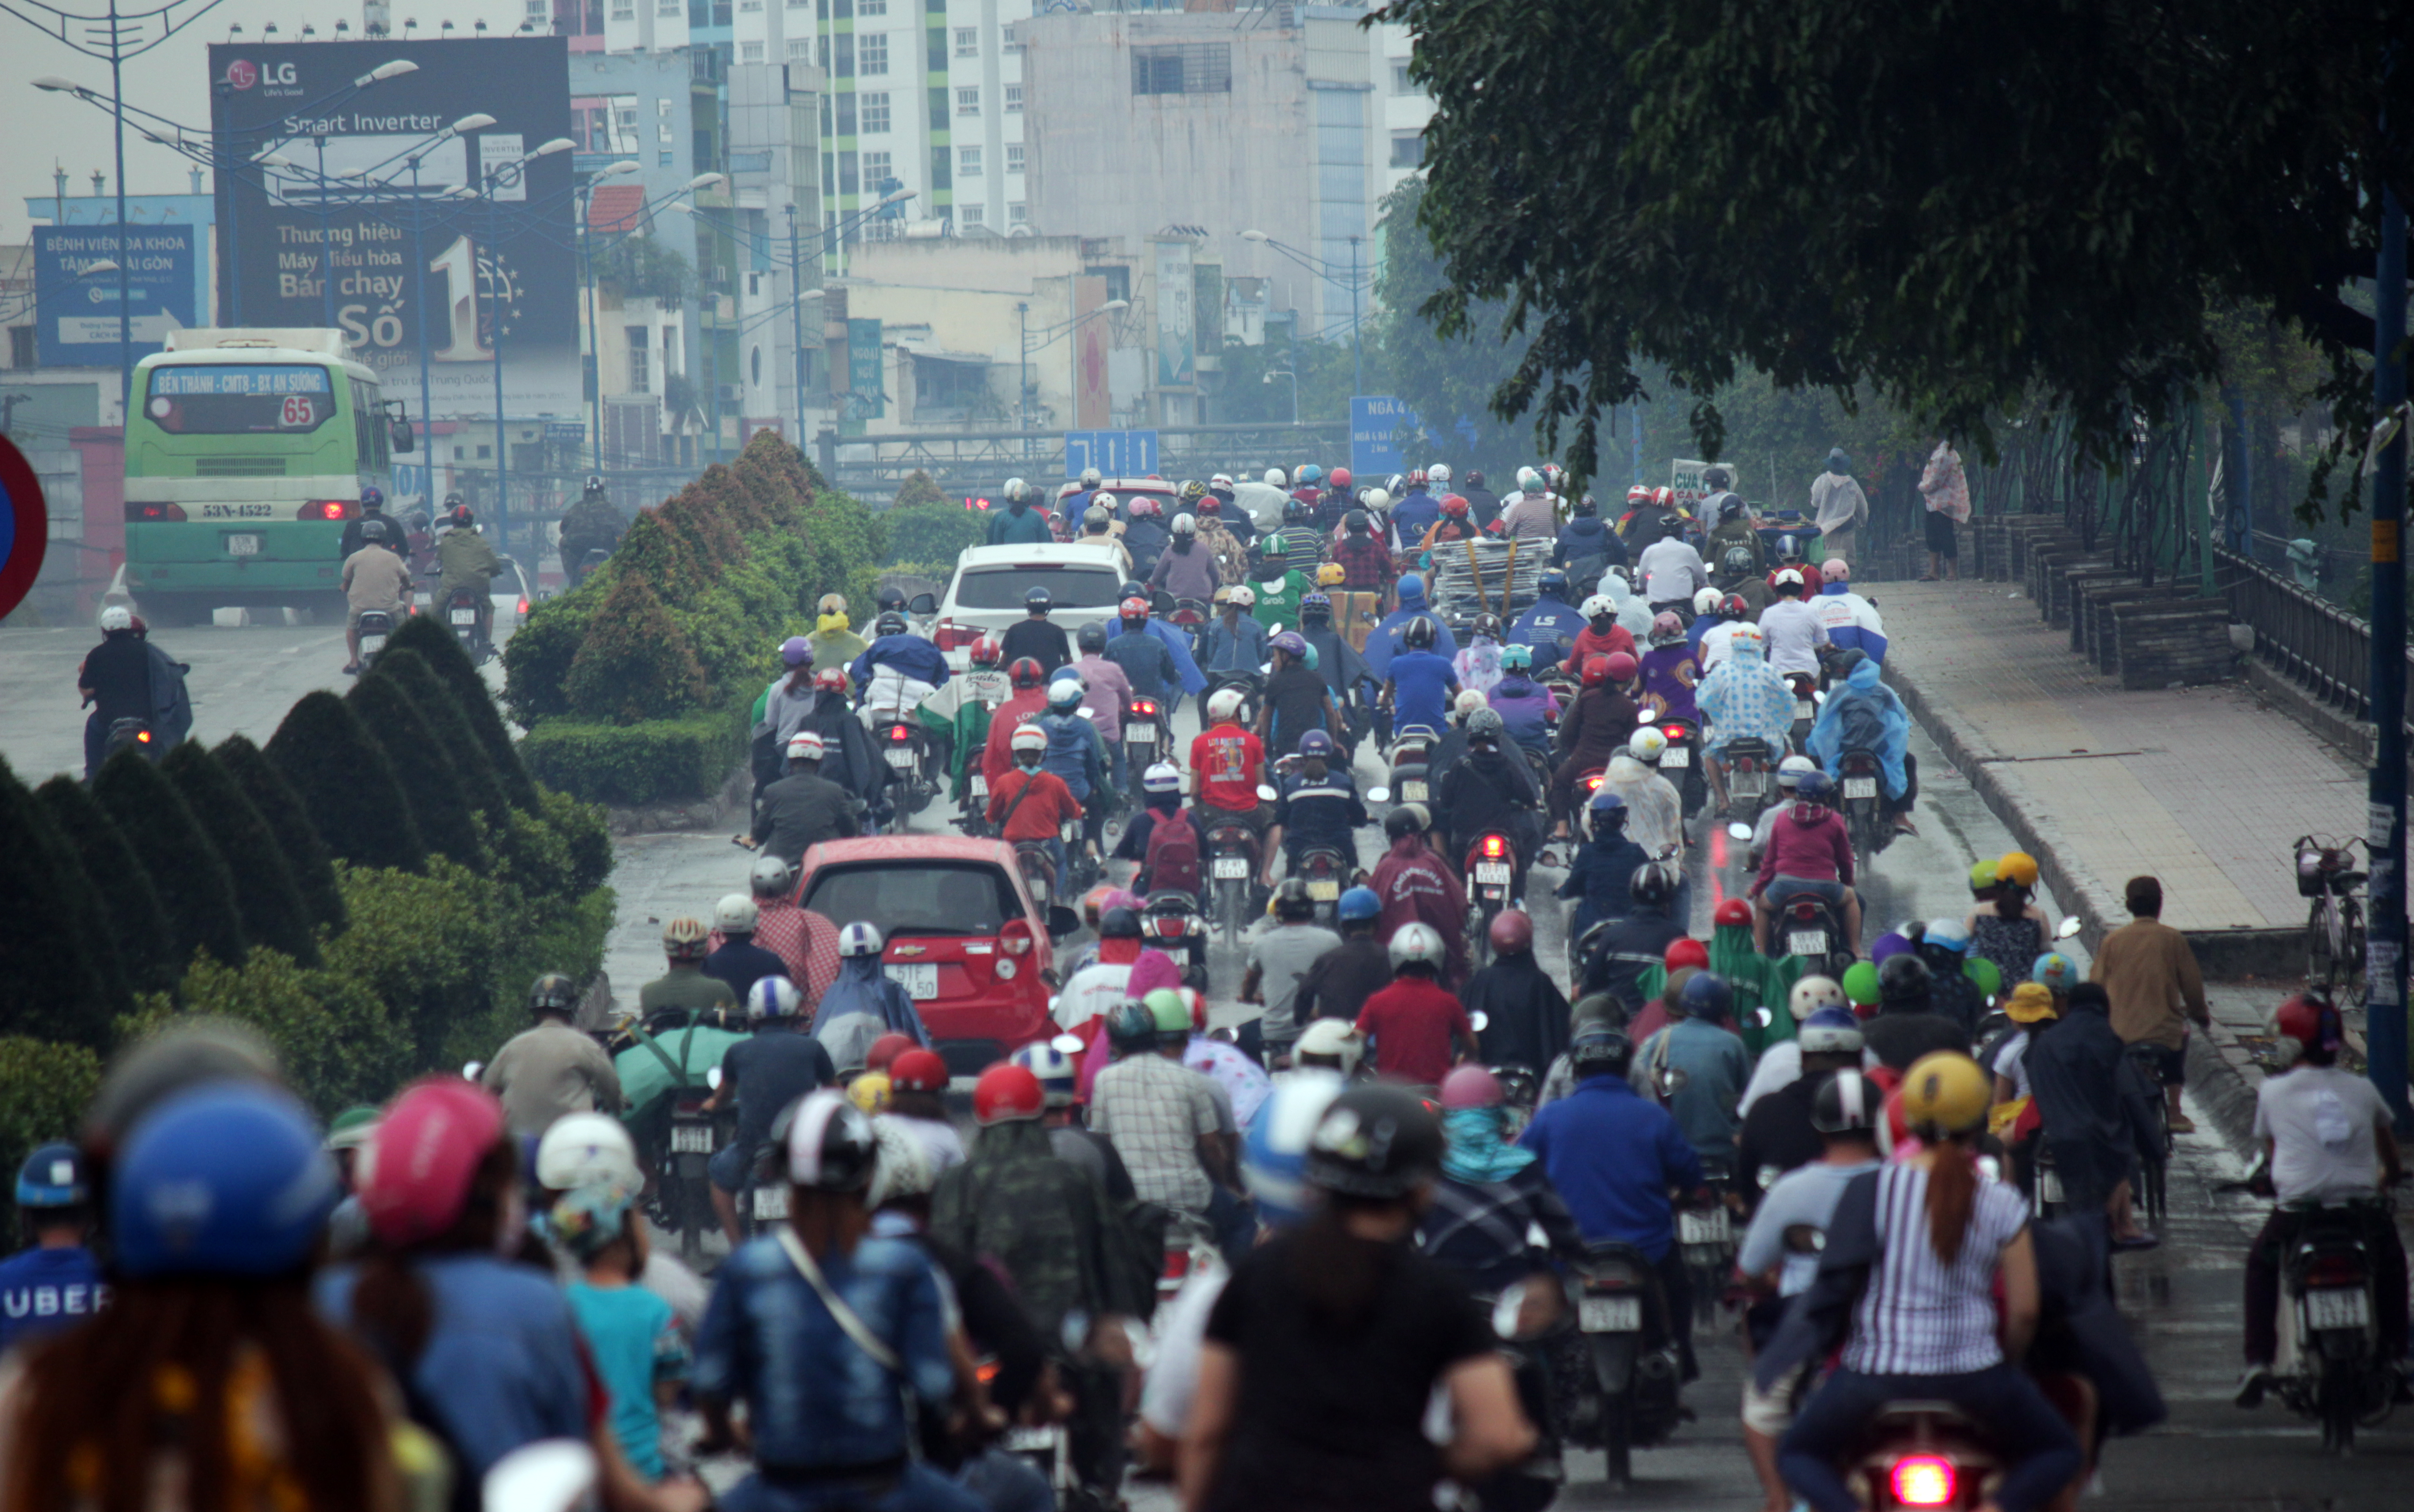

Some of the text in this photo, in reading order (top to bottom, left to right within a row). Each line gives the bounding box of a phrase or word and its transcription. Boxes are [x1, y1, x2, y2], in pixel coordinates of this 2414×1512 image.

[262, 62, 297, 86] LG
[284, 113, 442, 134] Smart Inverter
[359, 222, 402, 243] hiệu
[46, 236, 85, 255] BỆNH
[146, 236, 186, 252] KHOA
[279, 252, 318, 273] Máy
[367, 249, 403, 266] hòa
[340, 270, 404, 300] chạy
[338, 299, 405, 348] Số
[159, 369, 180, 393] BẾN
[181, 371, 214, 393] THÀNH
[222, 375, 250, 392] CMT8
[258, 374, 271, 392] BX
[274, 373, 287, 392] AN
[430, 375, 461, 387] Trung
[284, 398, 310, 423] 65
[1397, 400, 1405, 414] 4
[1377, 444, 1388, 452] km
[1675, 472, 1699, 489] CUA
[203, 504, 272, 518] 53N-4522
[1261, 595, 1285, 605] Grab
[1533, 615, 1557, 626] LS
[897, 965, 922, 980] 51F
